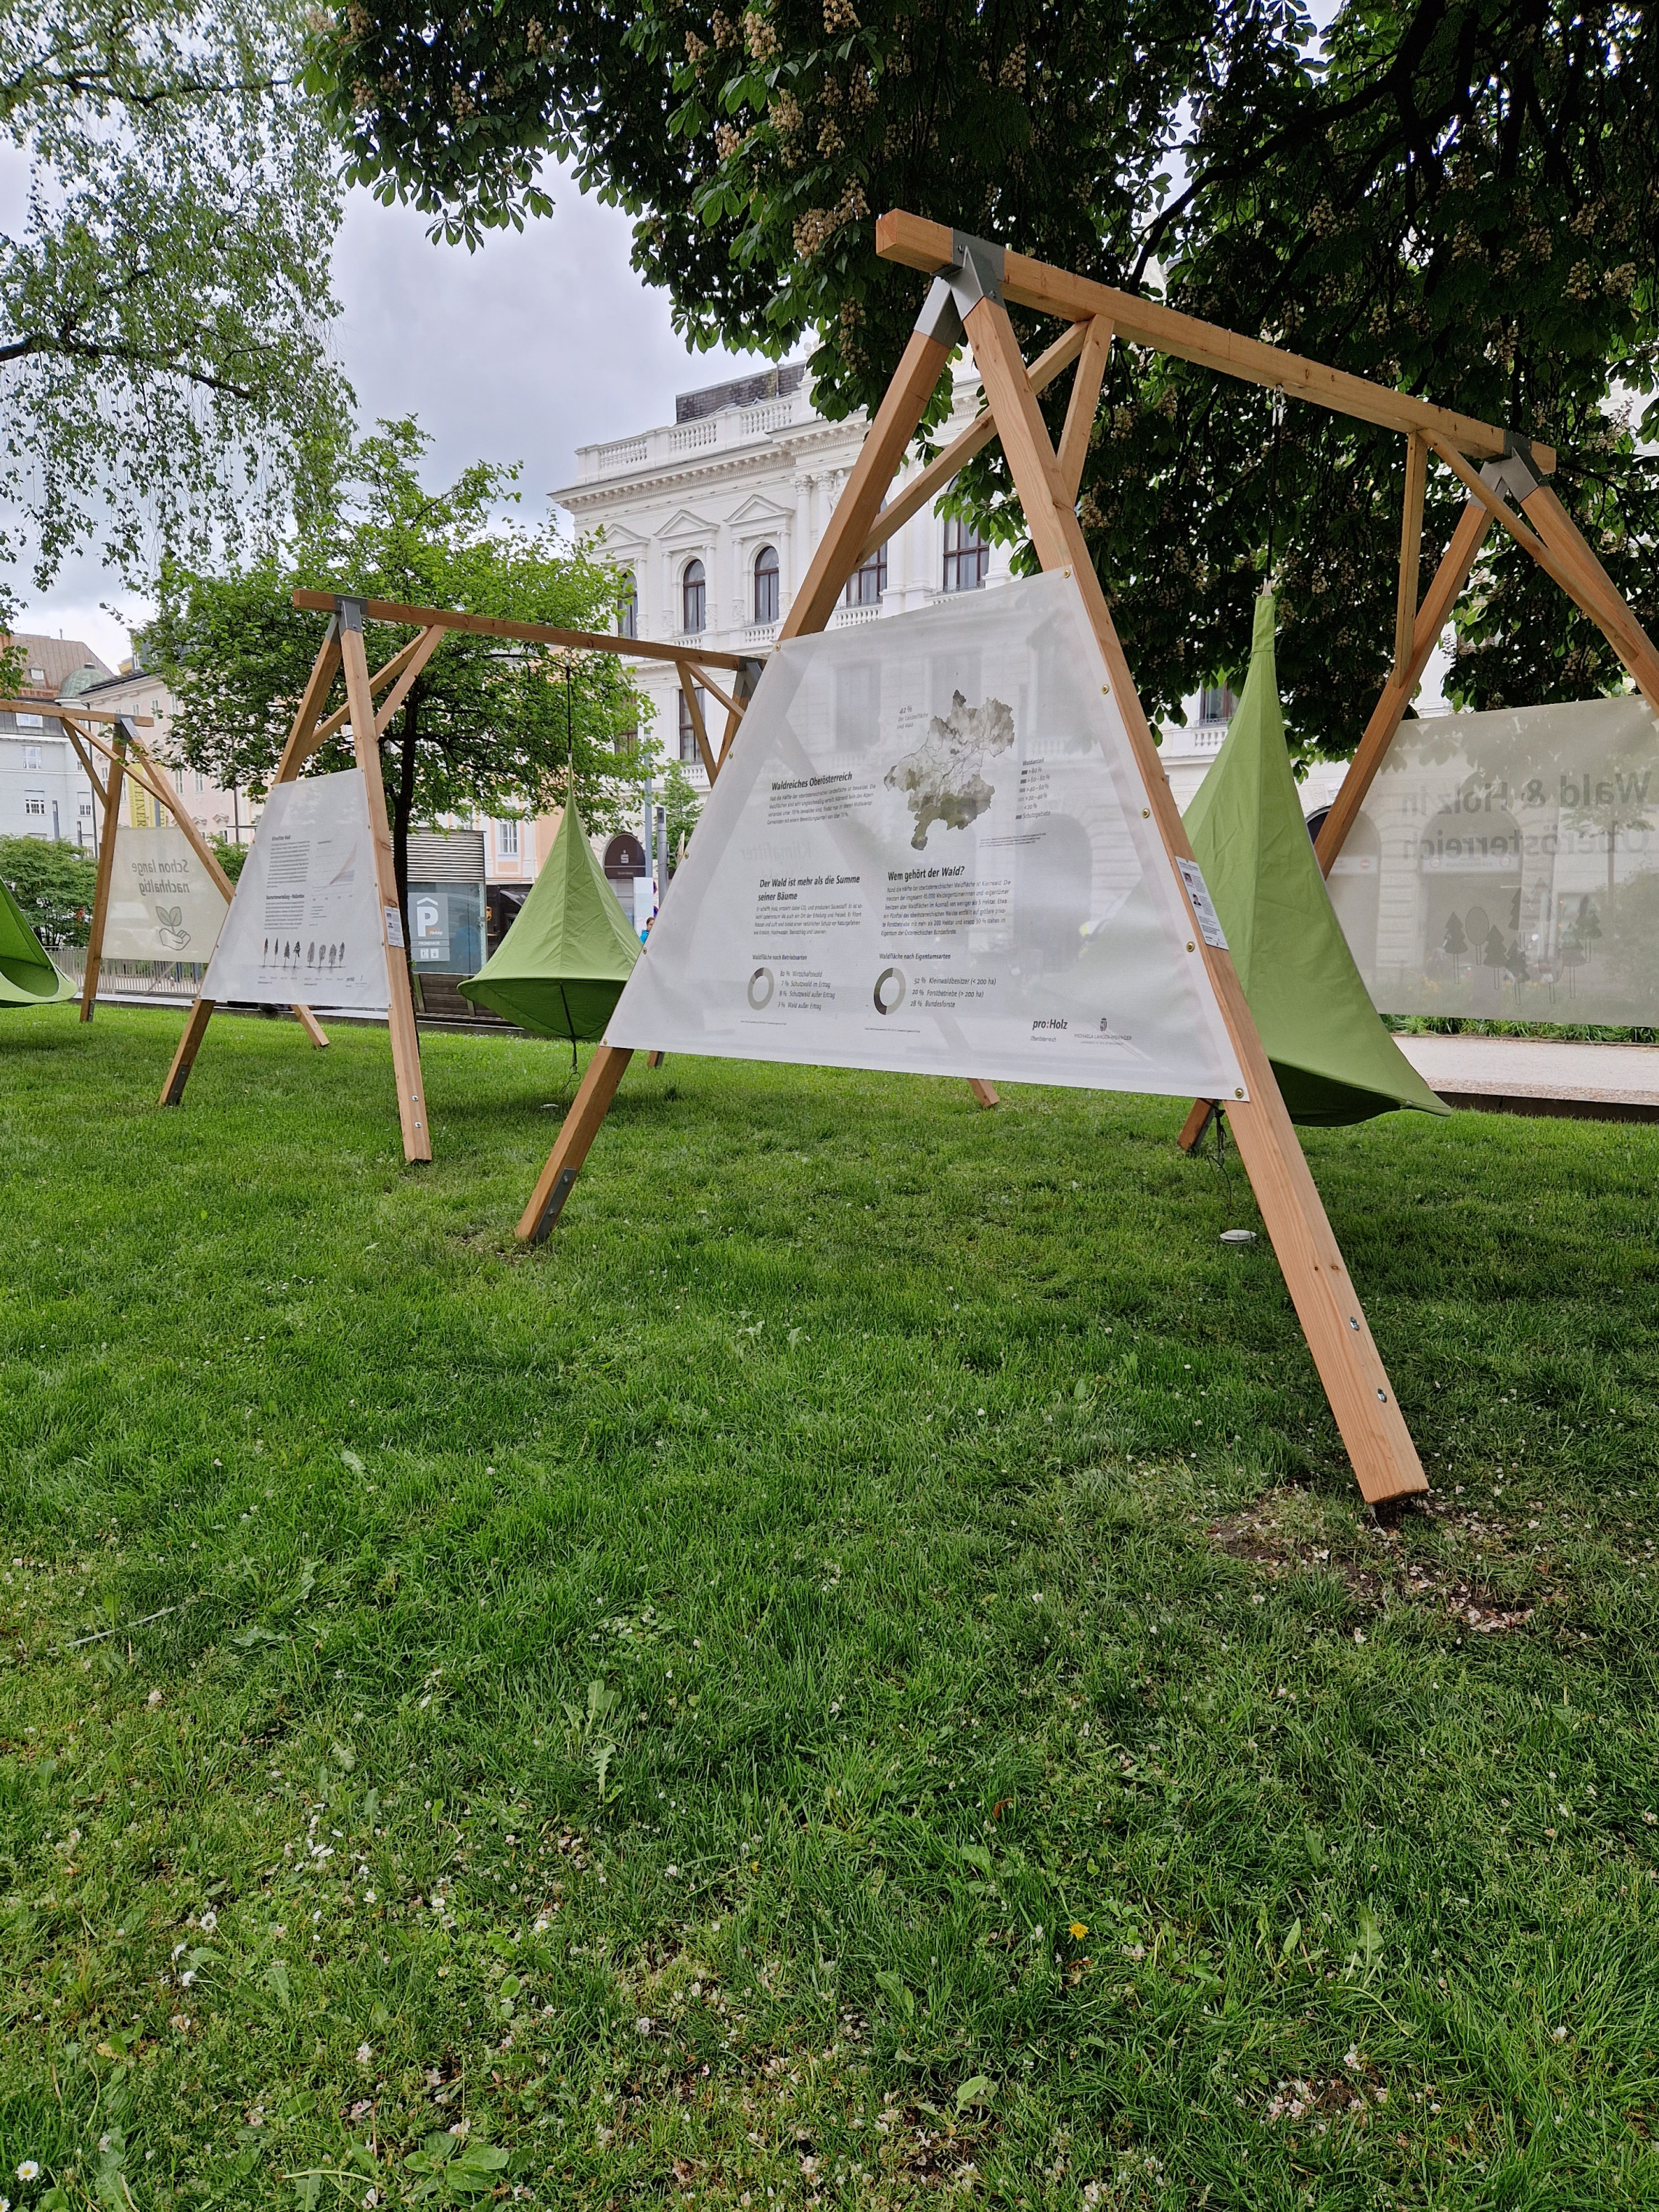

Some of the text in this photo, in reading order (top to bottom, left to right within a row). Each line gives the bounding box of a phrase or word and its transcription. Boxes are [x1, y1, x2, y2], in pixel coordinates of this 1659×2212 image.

[771, 771, 852, 791] Waldreiches Oberösterreich
[888, 866, 965, 882] Wem gehört der Wald?
[772, 878, 786, 887] Wald
[797, 877, 813, 886] mehr
[814, 876, 823, 885] als
[825, 875, 834, 884] die
[836, 875, 860, 884] Summe
[758, 891, 798, 901] seiner Bäume
[417, 906, 438, 937] P
[988, 977, 996, 986] ha)
[1032, 1019, 1068, 1031] pro:Holz
